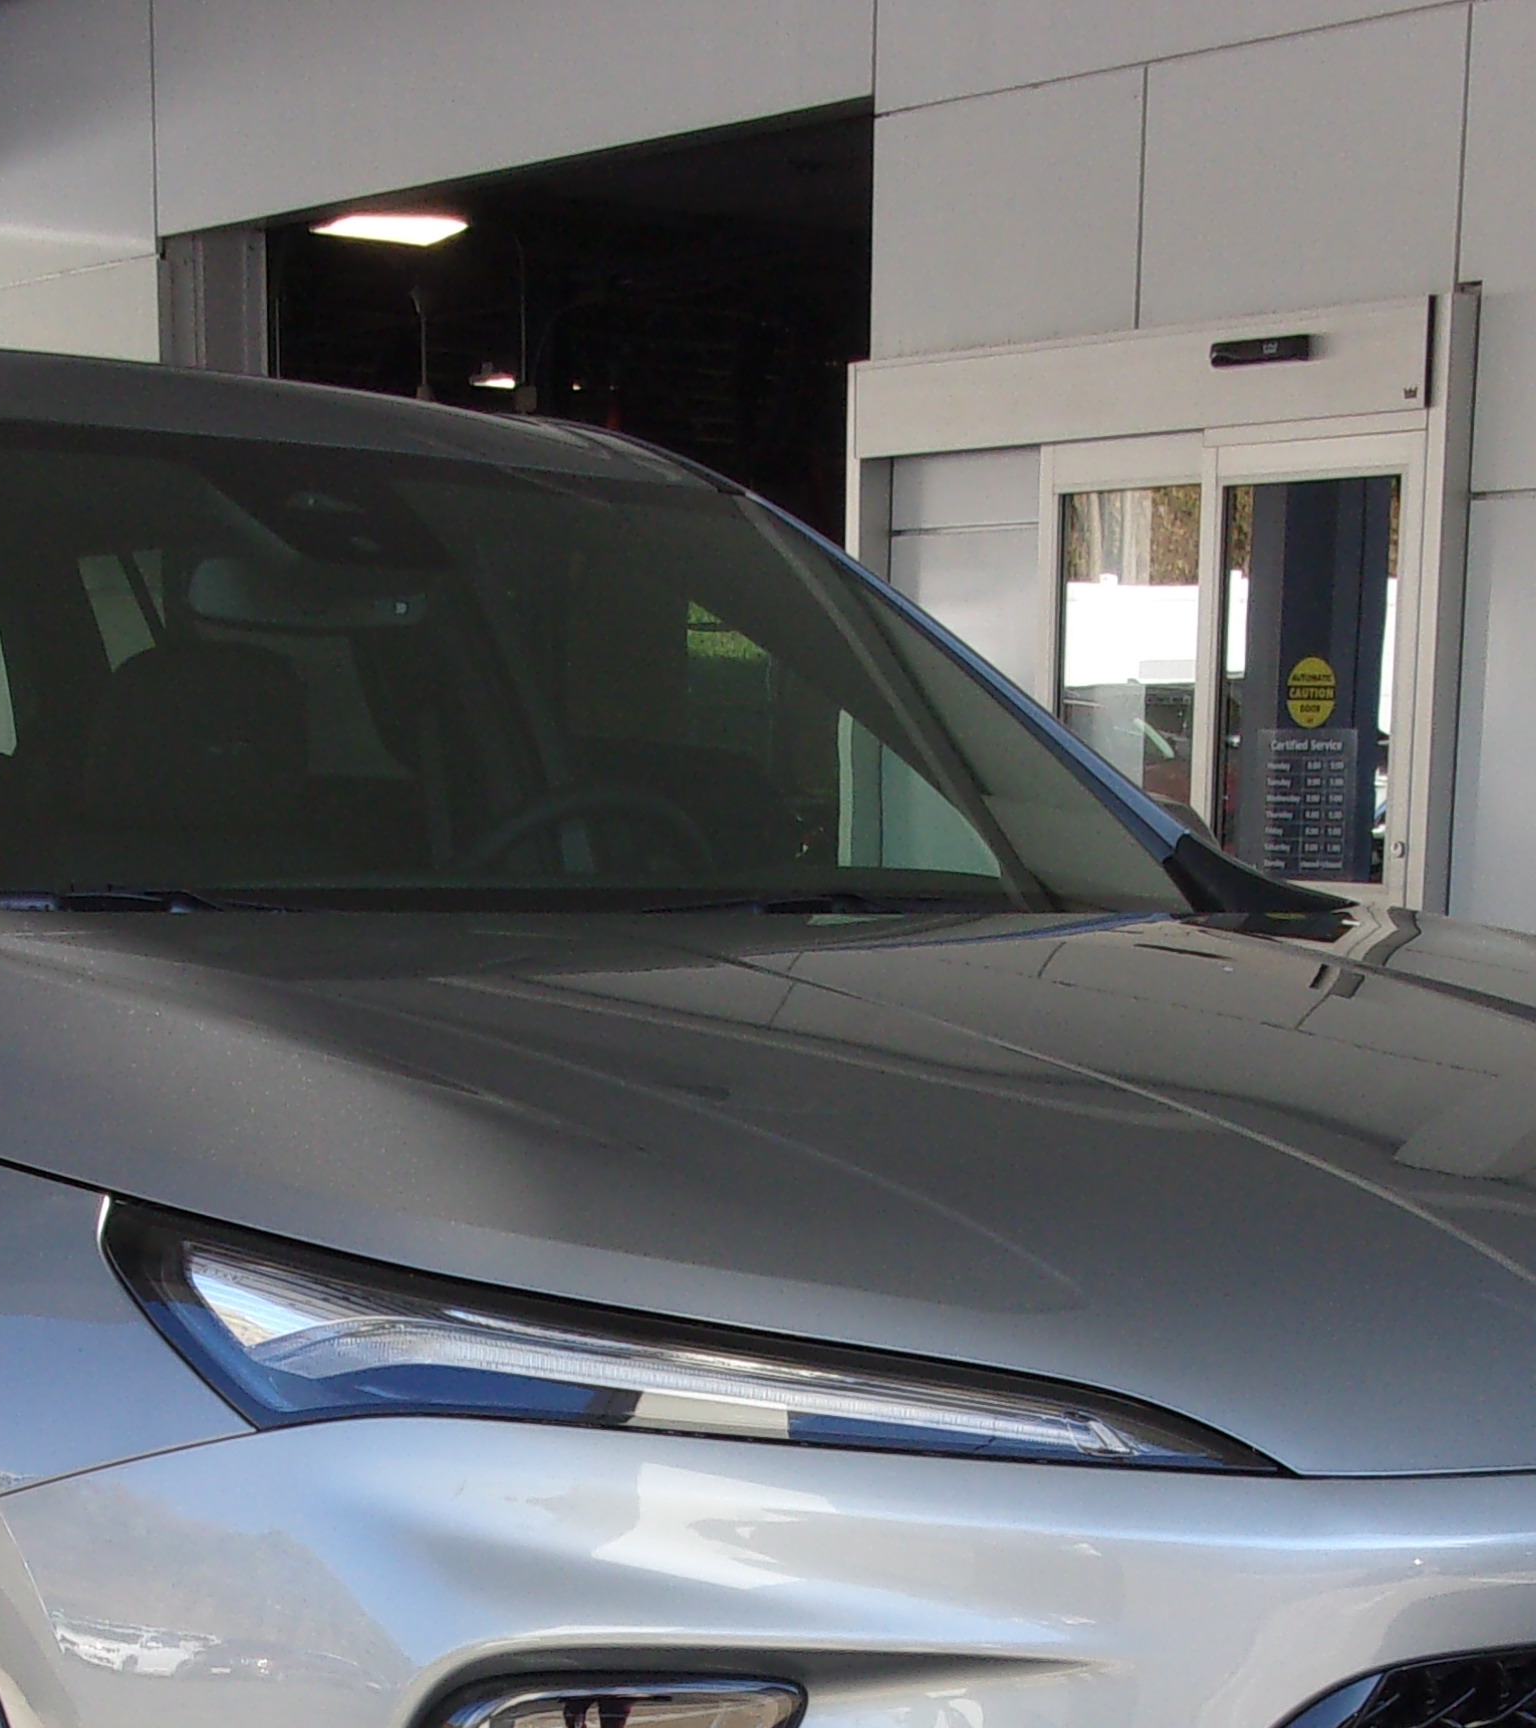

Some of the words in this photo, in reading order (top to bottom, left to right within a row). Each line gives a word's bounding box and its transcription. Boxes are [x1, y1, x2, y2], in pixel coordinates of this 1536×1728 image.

[1291, 673, 1333, 682] AUTOMATIC
[1289, 687, 1334, 699] CAUTION
[1299, 704, 1321, 713] DOOR
[1270, 739, 1309, 751] Certified
[1310, 739, 1343, 751] Service
